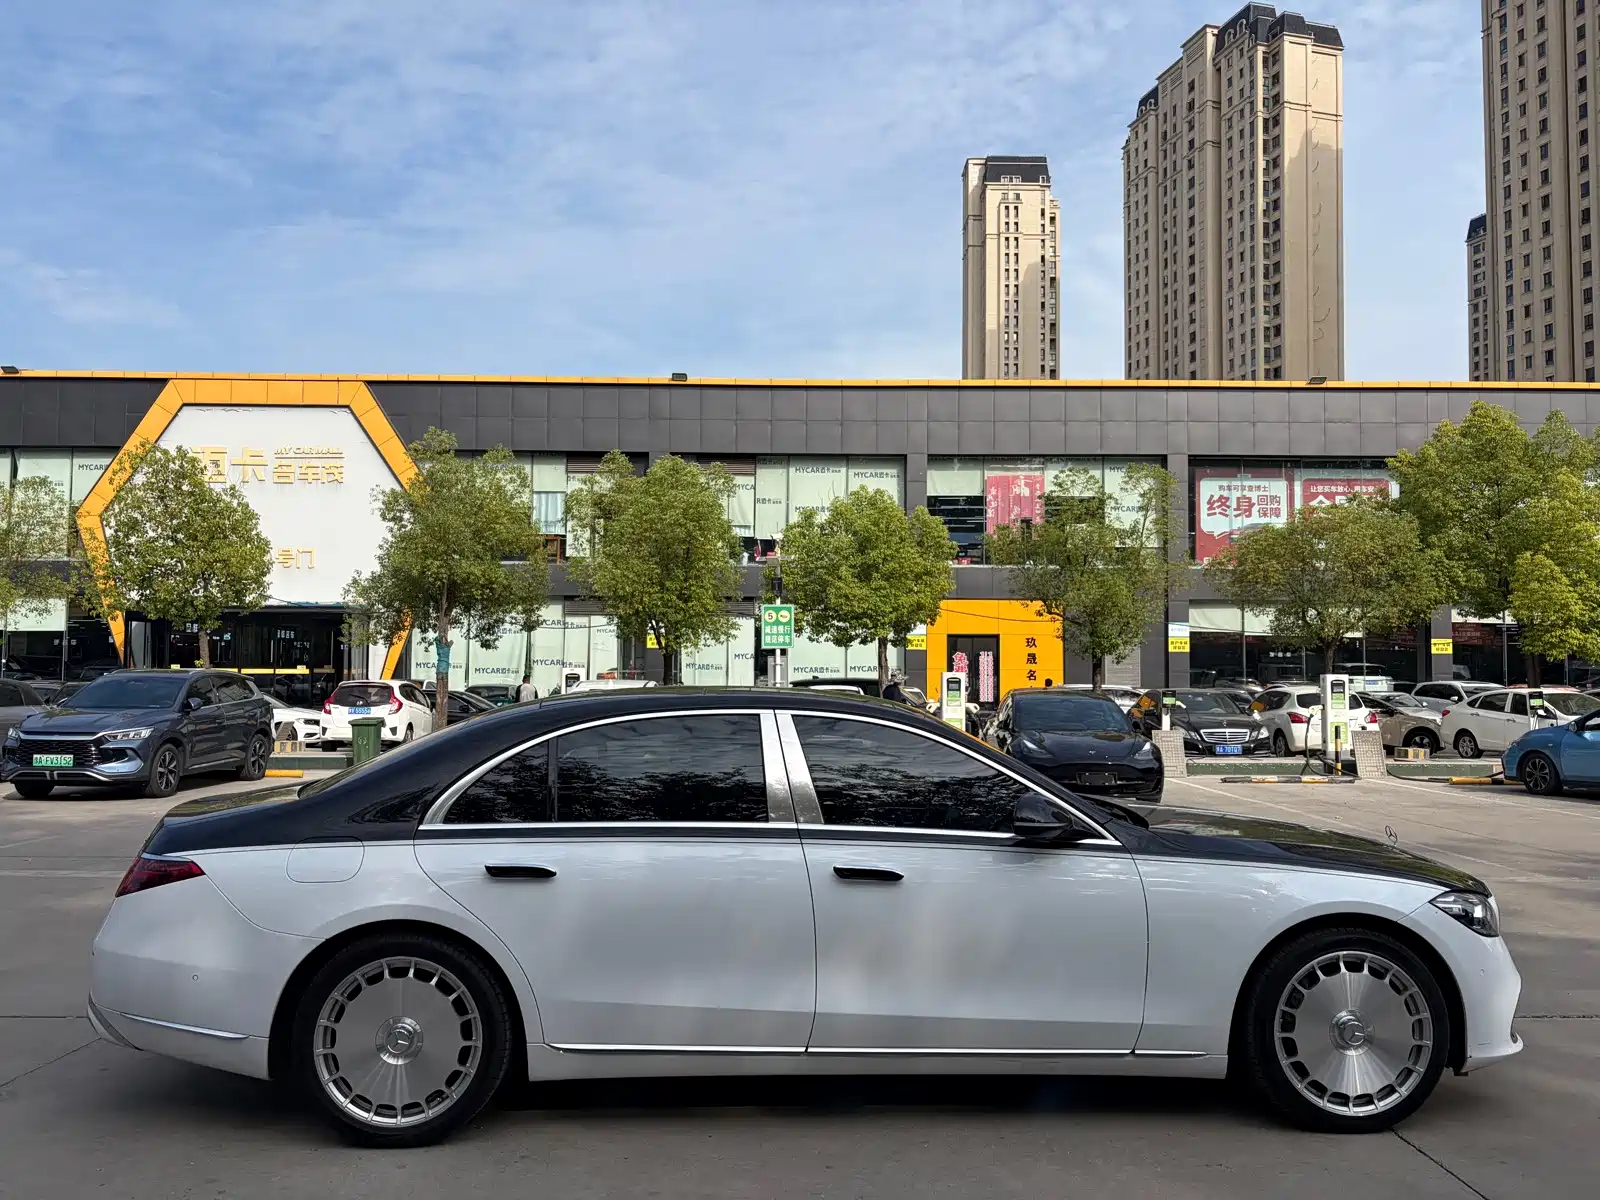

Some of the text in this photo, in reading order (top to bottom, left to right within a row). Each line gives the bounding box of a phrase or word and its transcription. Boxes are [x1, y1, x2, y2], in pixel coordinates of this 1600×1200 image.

[1206, 494, 1256, 518] 终身
[1257, 495, 1281, 506] 回购
[1257, 507, 1281, 518] 保障
[275, 547, 316, 570] 号门
[767, 612, 774, 620] 5
[1026, 637, 1038, 688] 玖晟名
